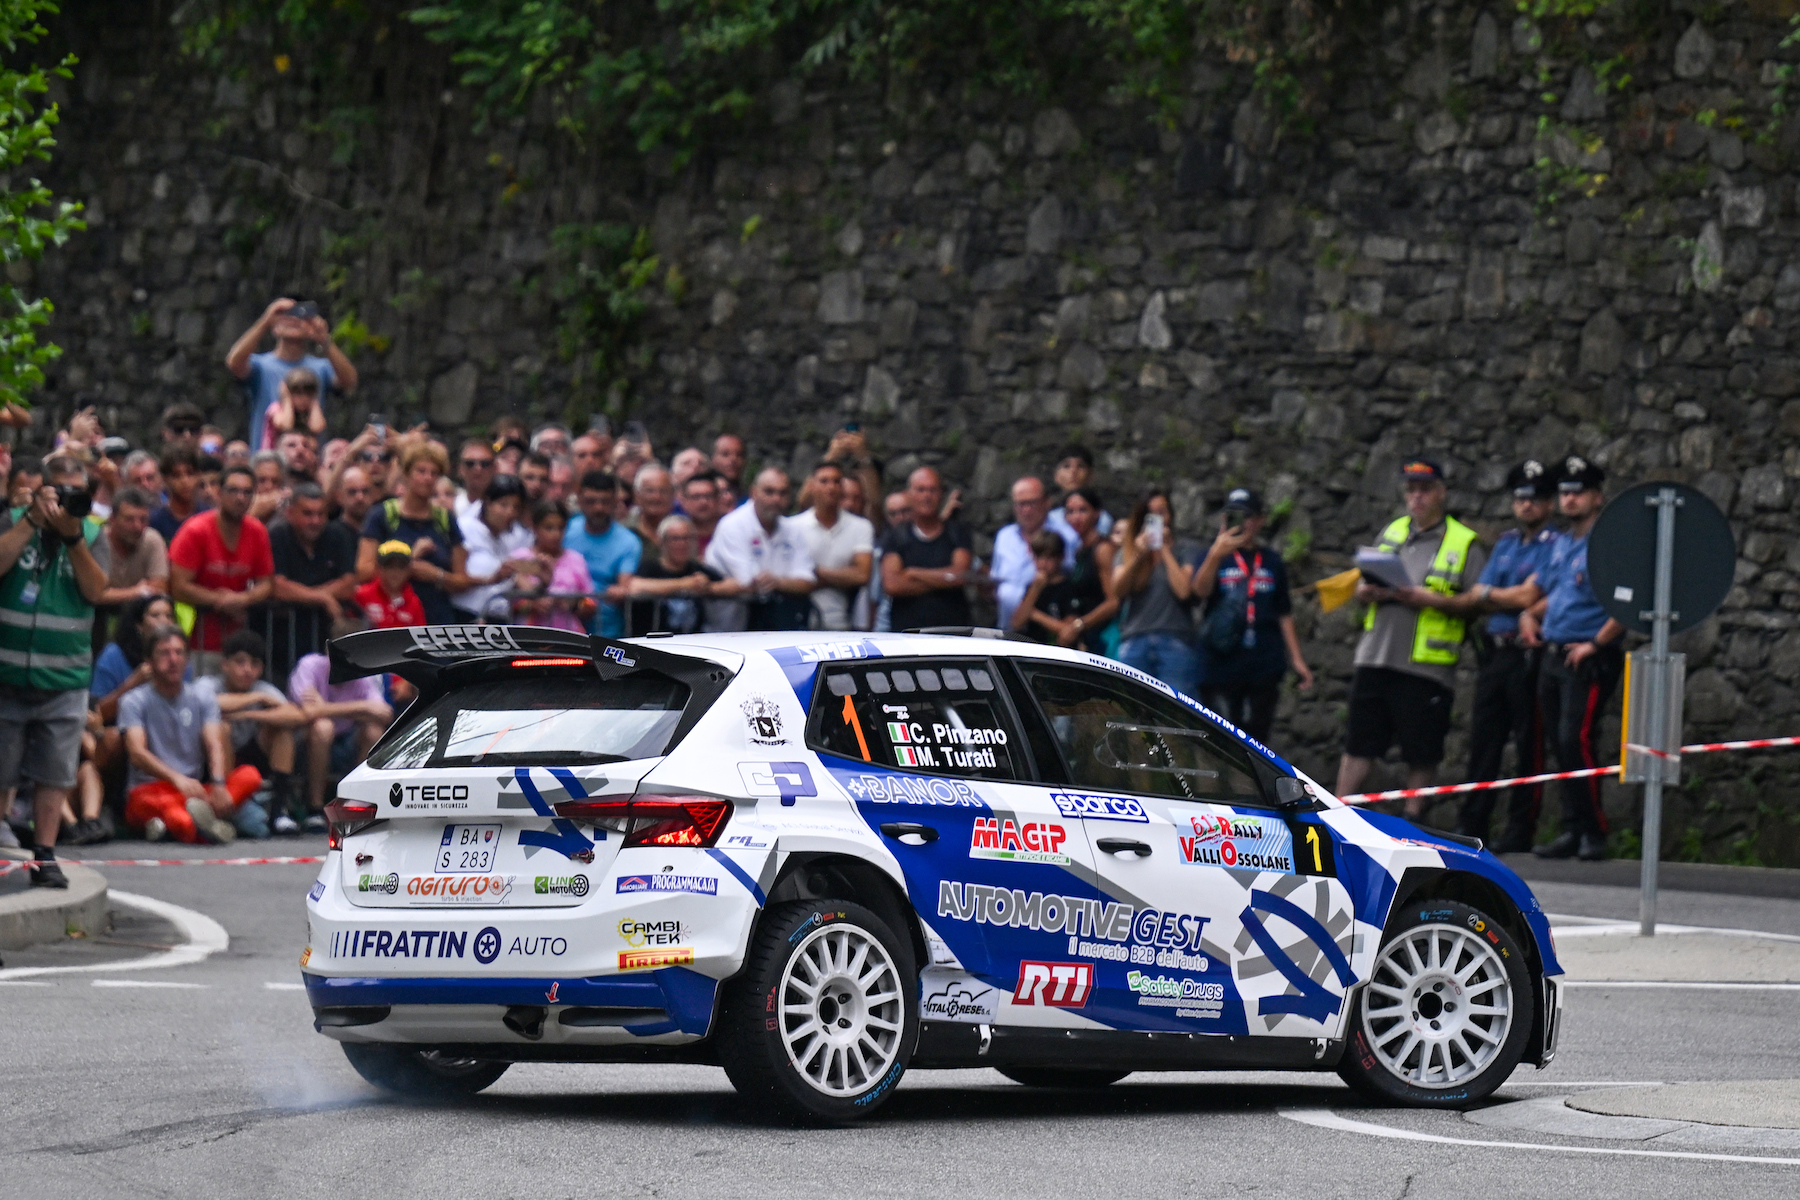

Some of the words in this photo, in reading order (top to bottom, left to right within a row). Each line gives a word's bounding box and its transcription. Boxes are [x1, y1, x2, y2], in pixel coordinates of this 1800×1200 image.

[408, 627, 521, 650] EFFECI
[797, 641, 865, 662] SIMET
[1089, 657, 1107, 667] NEW
[1109, 664, 1144, 682] DRIVERS
[1145, 677, 1168, 690] TEAM
[842, 695, 872, 762] 1
[909, 722, 932, 744] C.
[932, 723, 1008, 745] Pinzano
[1188, 698, 1236, 733] FRATTIN
[1248, 737, 1276, 759] AUTO
[915, 746, 940, 767] M.
[940, 746, 997, 768] Turati
[405, 785, 469, 801] TECO
[860, 775, 983, 807] BANOR
[1055, 794, 1143, 816] sparco
[460, 828, 479, 846] BA
[972, 817, 1067, 853] MAGIP
[1215, 816, 1262, 839] RALLY
[441, 851, 451, 868] S
[460, 851, 489, 868] 283
[1306, 825, 1323, 872] 1
[651, 875, 716, 892] PROGRAMMACASA
[622, 921, 680, 934] CAMBI
[644, 933, 681, 945] TEK
[360, 930, 468, 958] FRATTIN
[508, 937, 567, 956] AUTO
[1068, 936, 1078, 955] il
[1079, 941, 1130, 962] mercato
[1130, 944, 1156, 965] B2B
[1156, 948, 1209, 972] dell'auto
[619, 949, 691, 969] PIRELLI
[1018, 964, 1089, 1007] RTI
